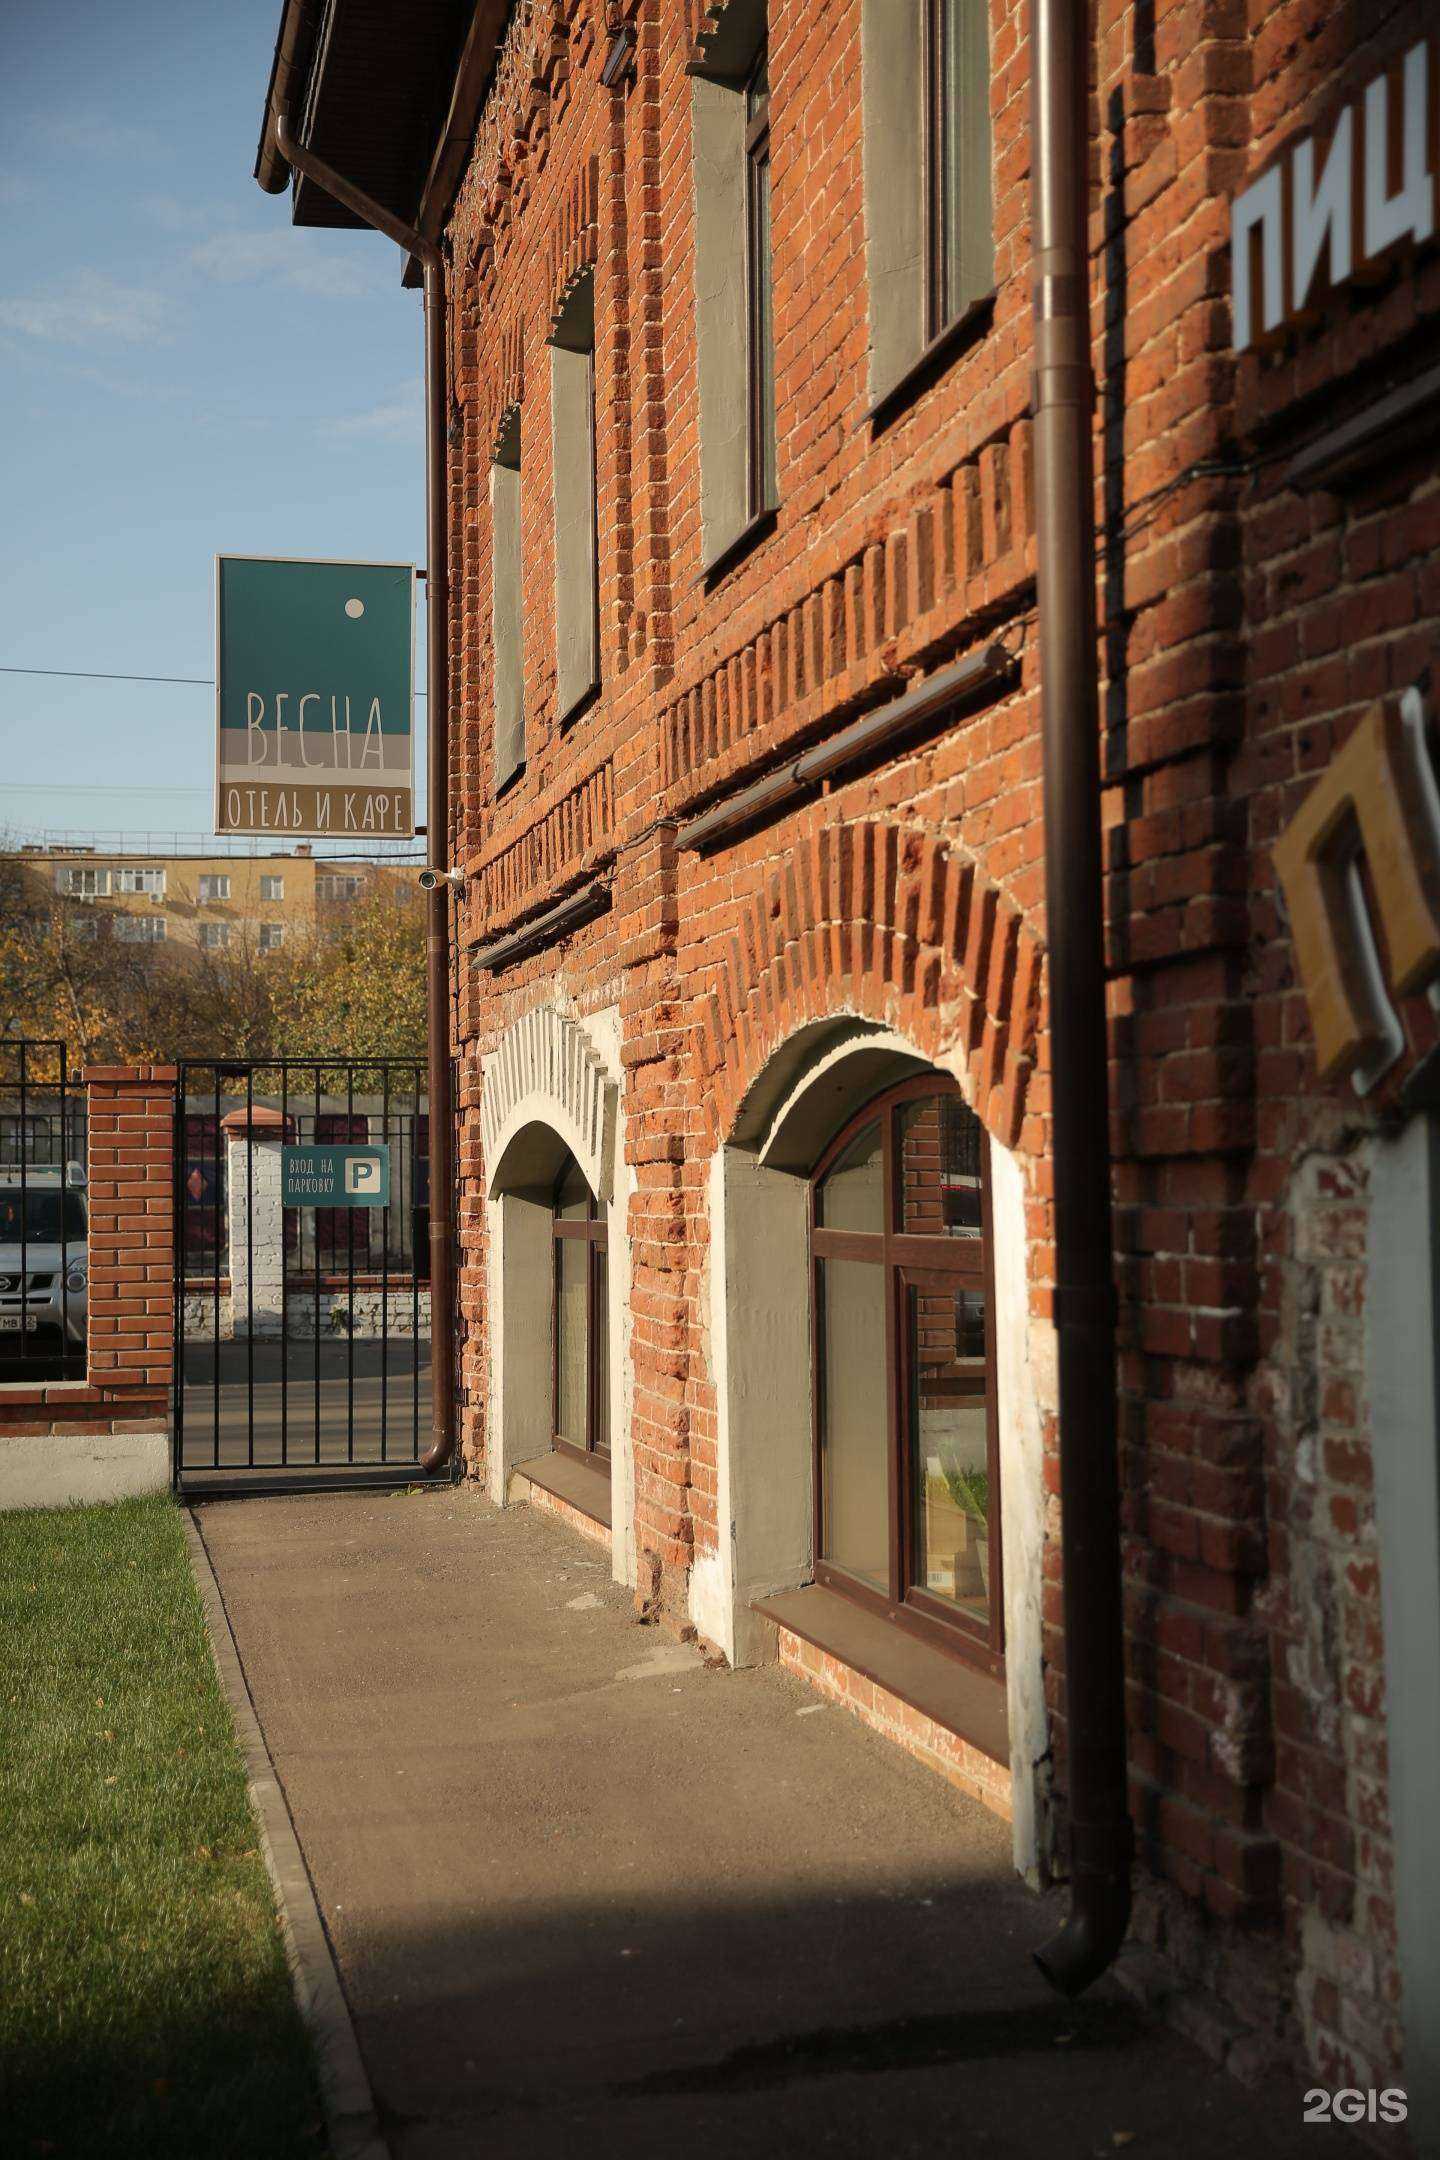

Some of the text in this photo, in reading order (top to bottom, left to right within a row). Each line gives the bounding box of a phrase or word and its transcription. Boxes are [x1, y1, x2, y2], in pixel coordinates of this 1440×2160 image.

[1232, 39, 1434, 353] ПИЦ
[247, 692, 385, 769] ВЕСНА
[227, 789, 403, 831] ОТЕЛЬ И КАФЕ
[288, 1178, 334, 1193] ПАРКОВКУ
[289, 1159, 333, 1174] ВХОД НА
